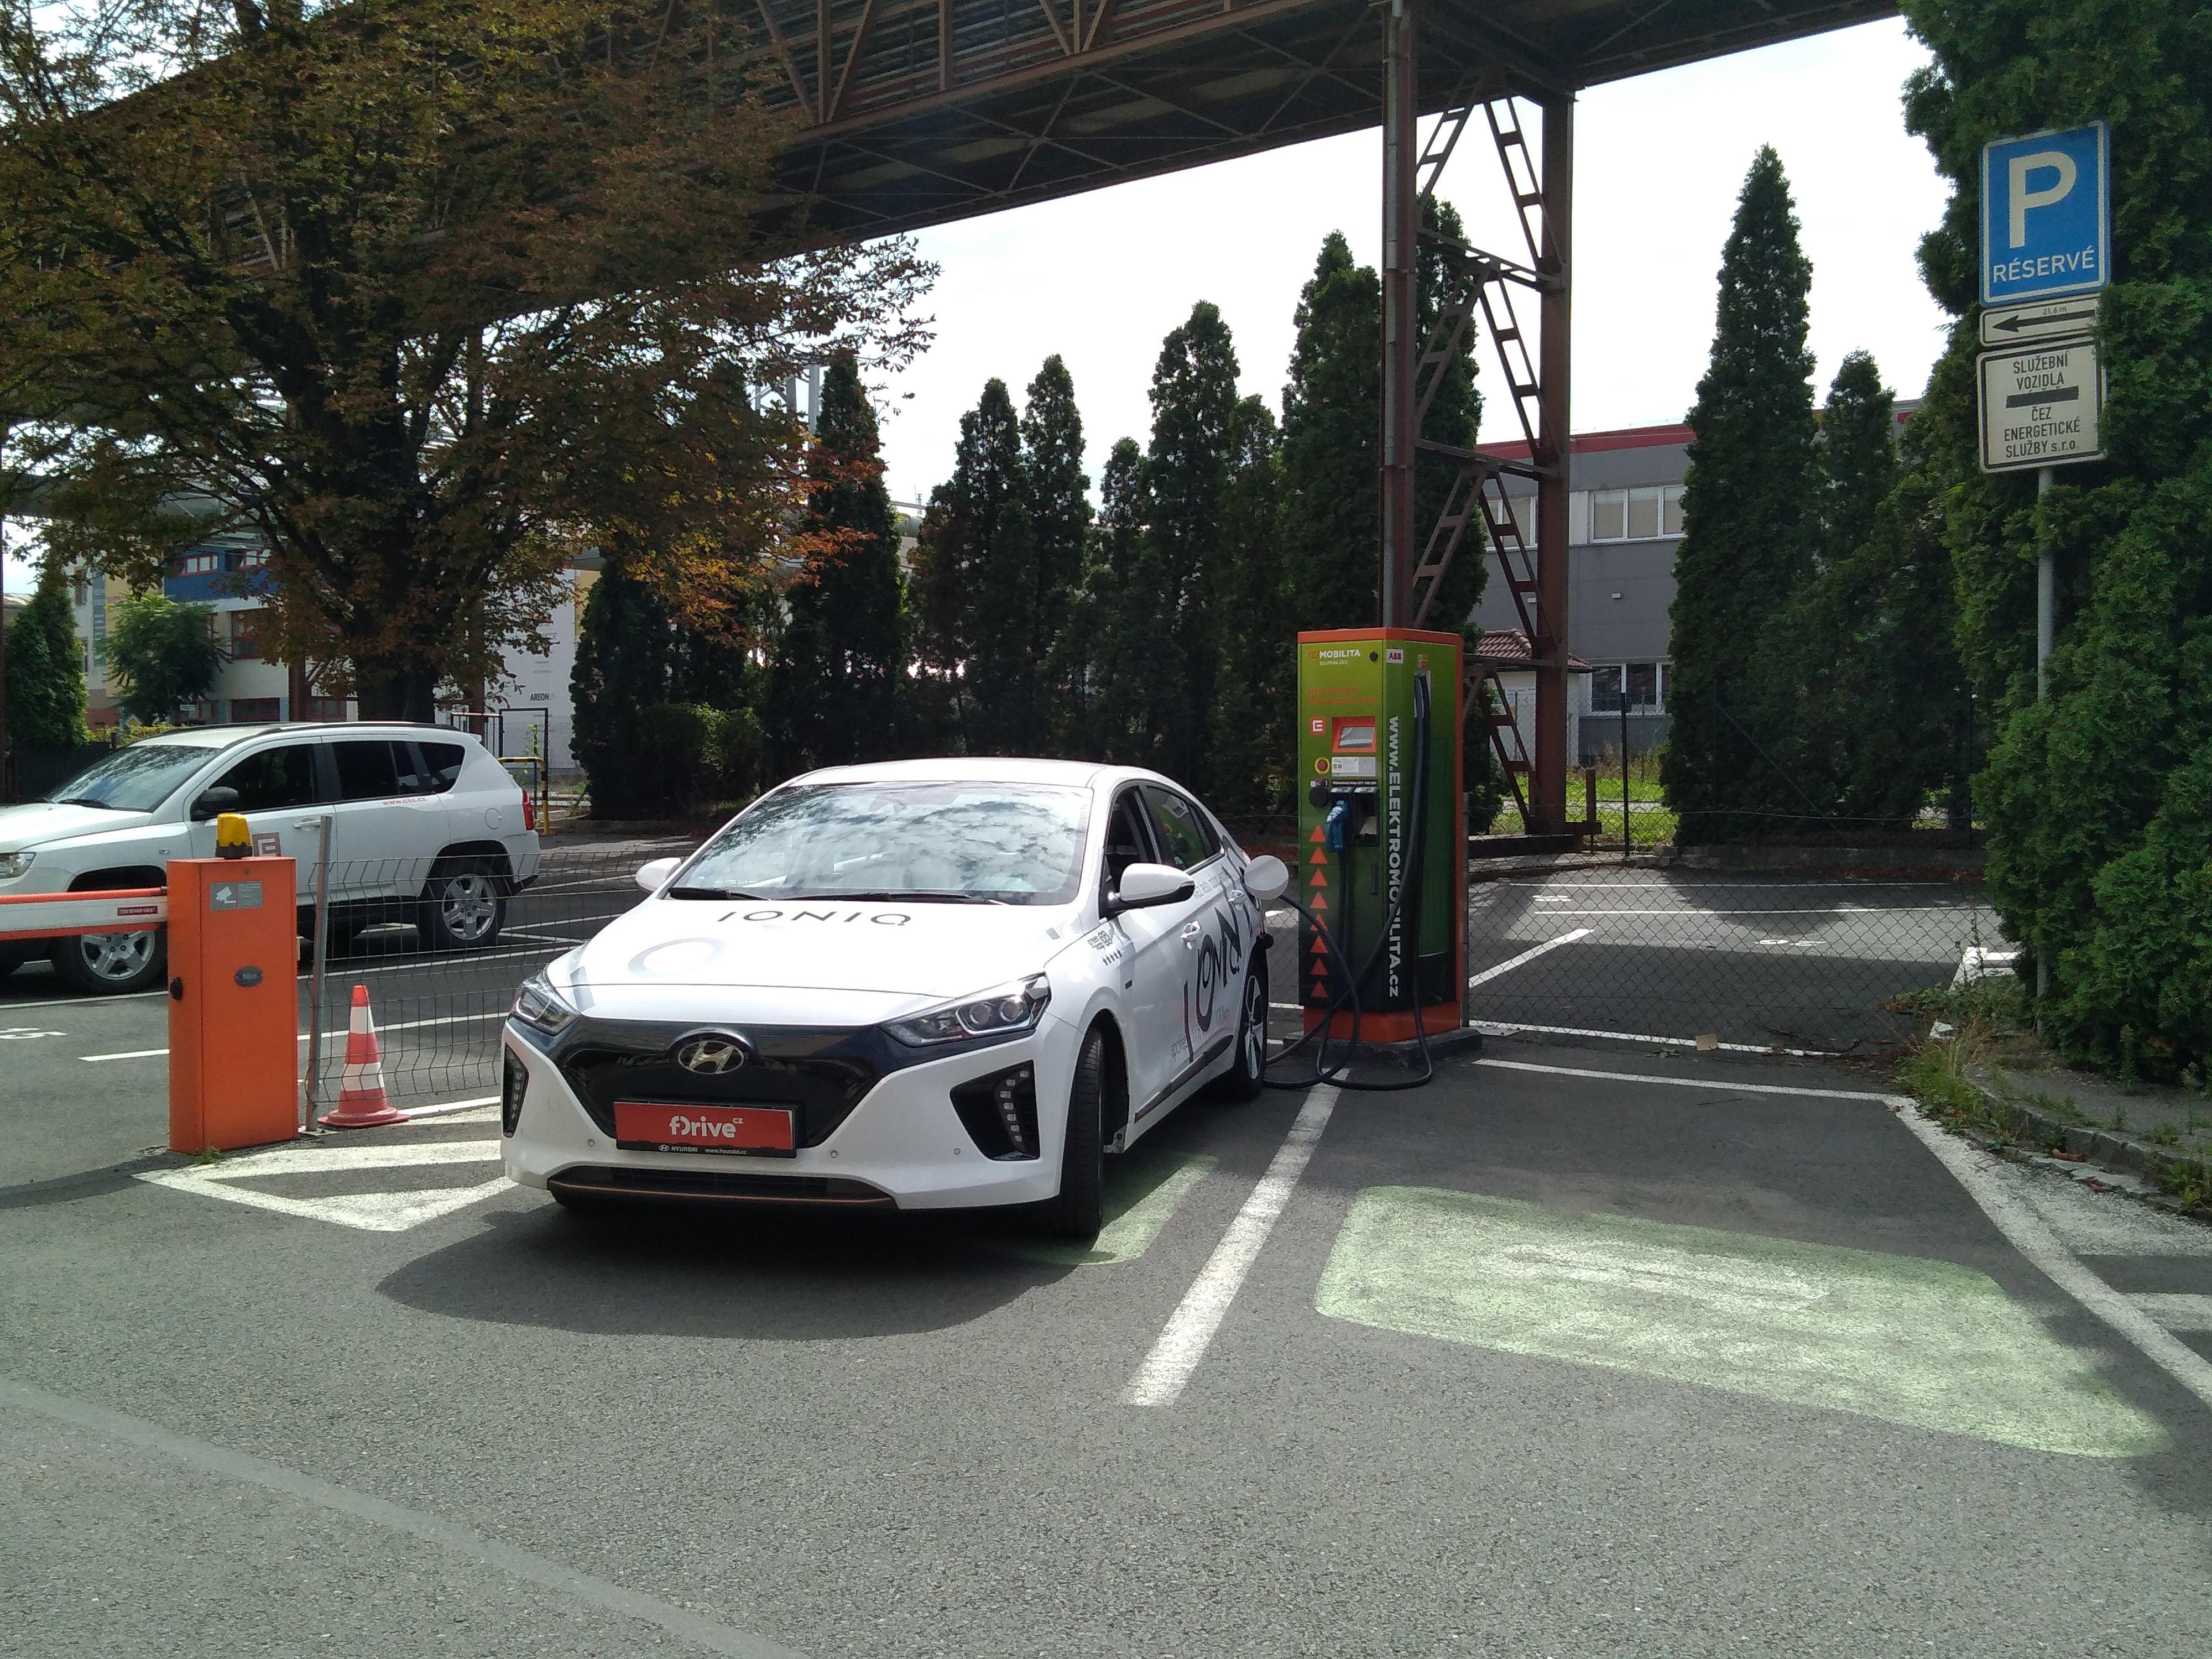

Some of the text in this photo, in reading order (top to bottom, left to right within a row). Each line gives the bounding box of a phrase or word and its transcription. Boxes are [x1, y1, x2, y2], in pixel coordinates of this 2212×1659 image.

[2009, 152, 2077, 248] P
[1993, 245, 2095, 283] RÉSERVÉ
[2013, 351, 2069, 374] SLUŽEBNÍ
[2016, 372, 2064, 390] VOZIDLA
[2032, 406, 2052, 421] ČEZ
[2004, 416, 2080, 442] ENERGETICKÉ
[2006, 440, 2048, 458] SLUŽBY
[530, 692, 550, 701] AREON
[717, 910, 912, 926] IONIQ
